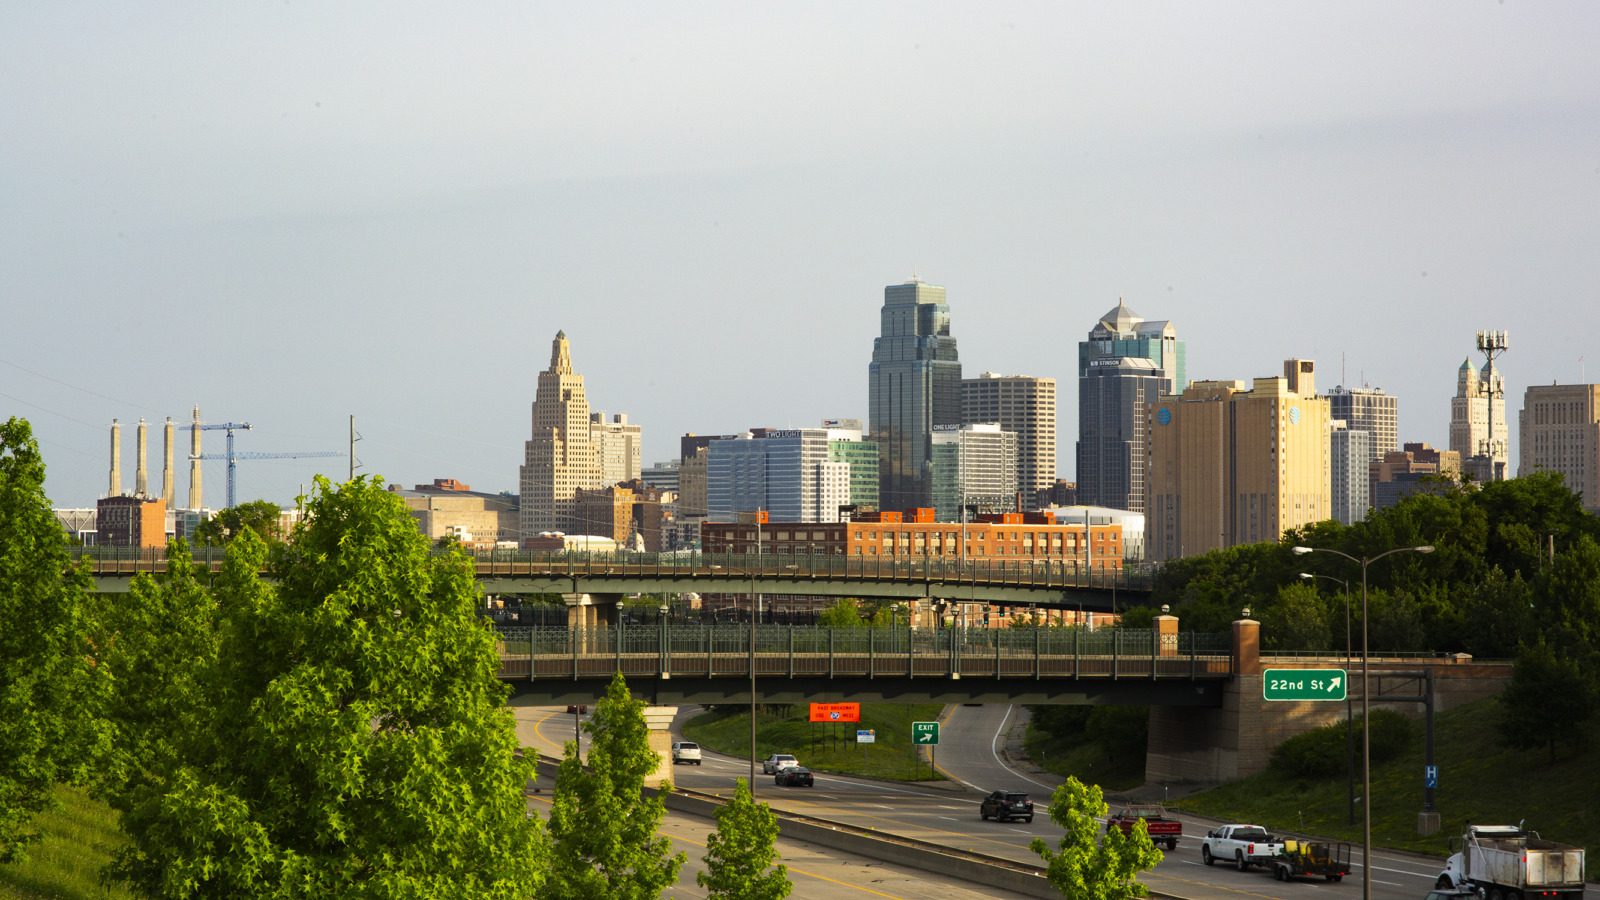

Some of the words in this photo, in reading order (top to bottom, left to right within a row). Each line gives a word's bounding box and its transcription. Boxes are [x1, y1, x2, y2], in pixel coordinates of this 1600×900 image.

[767, 430, 781, 438] TWO
[782, 430, 800, 438] LIGHT
[1270, 679, 1304, 690] 22nd
[1310, 679, 1324, 690] St
[1427, 766, 1436, 778] H
